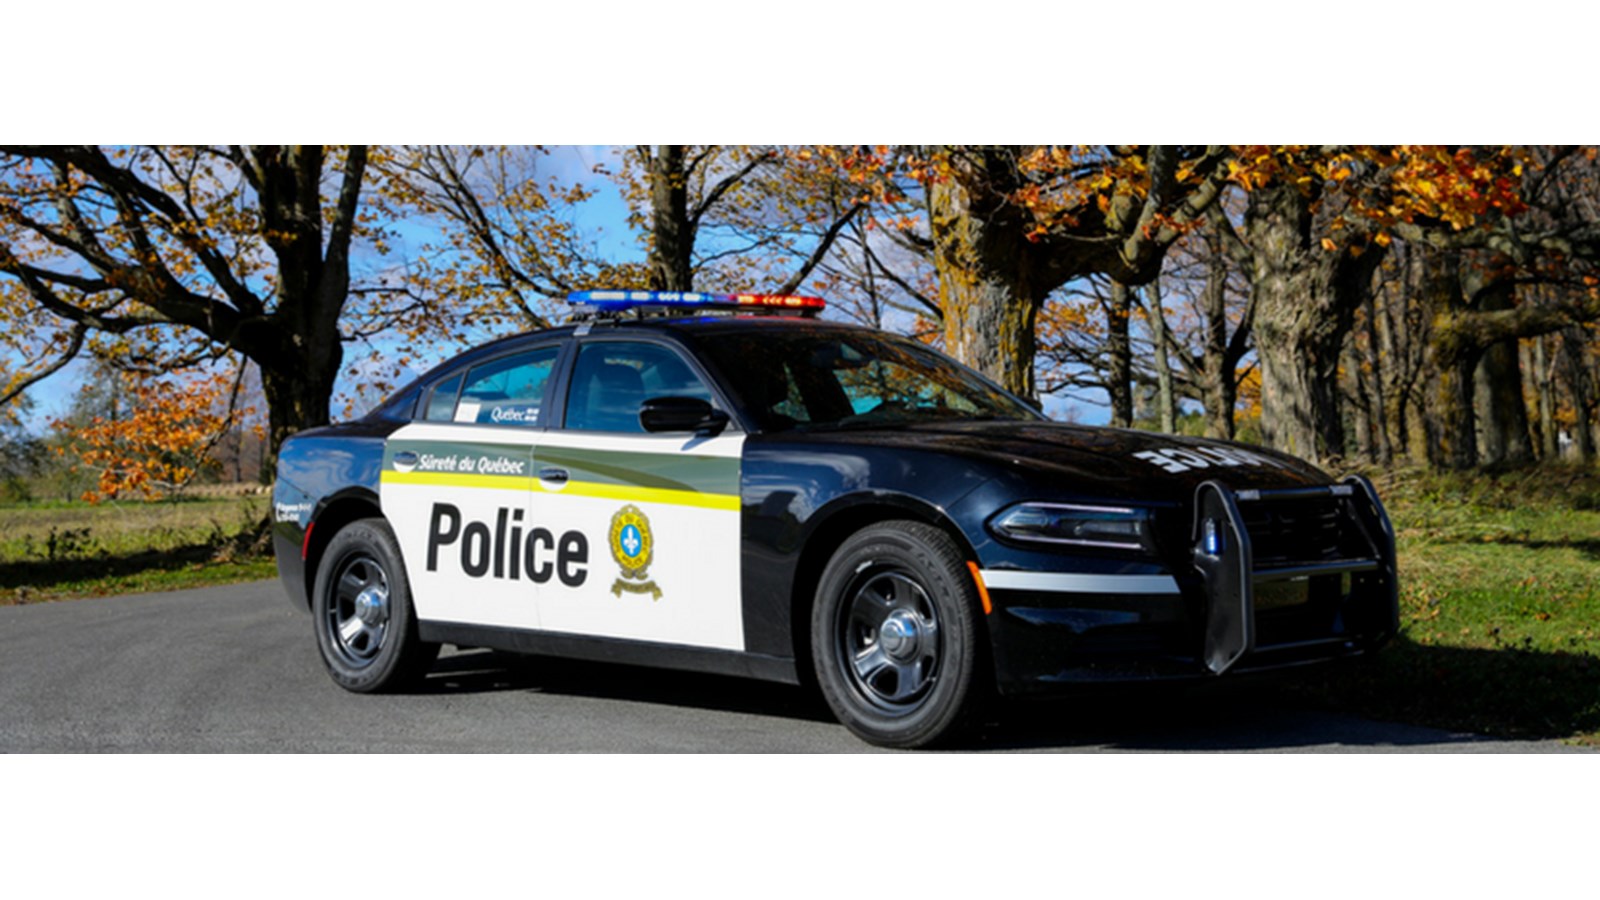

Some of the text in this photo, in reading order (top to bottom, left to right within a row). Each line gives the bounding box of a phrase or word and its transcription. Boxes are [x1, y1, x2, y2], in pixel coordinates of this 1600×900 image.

[491, 406, 524, 423] Québec
[419, 454, 525, 474] Sûreté du Québec
[426, 502, 589, 588] Police
